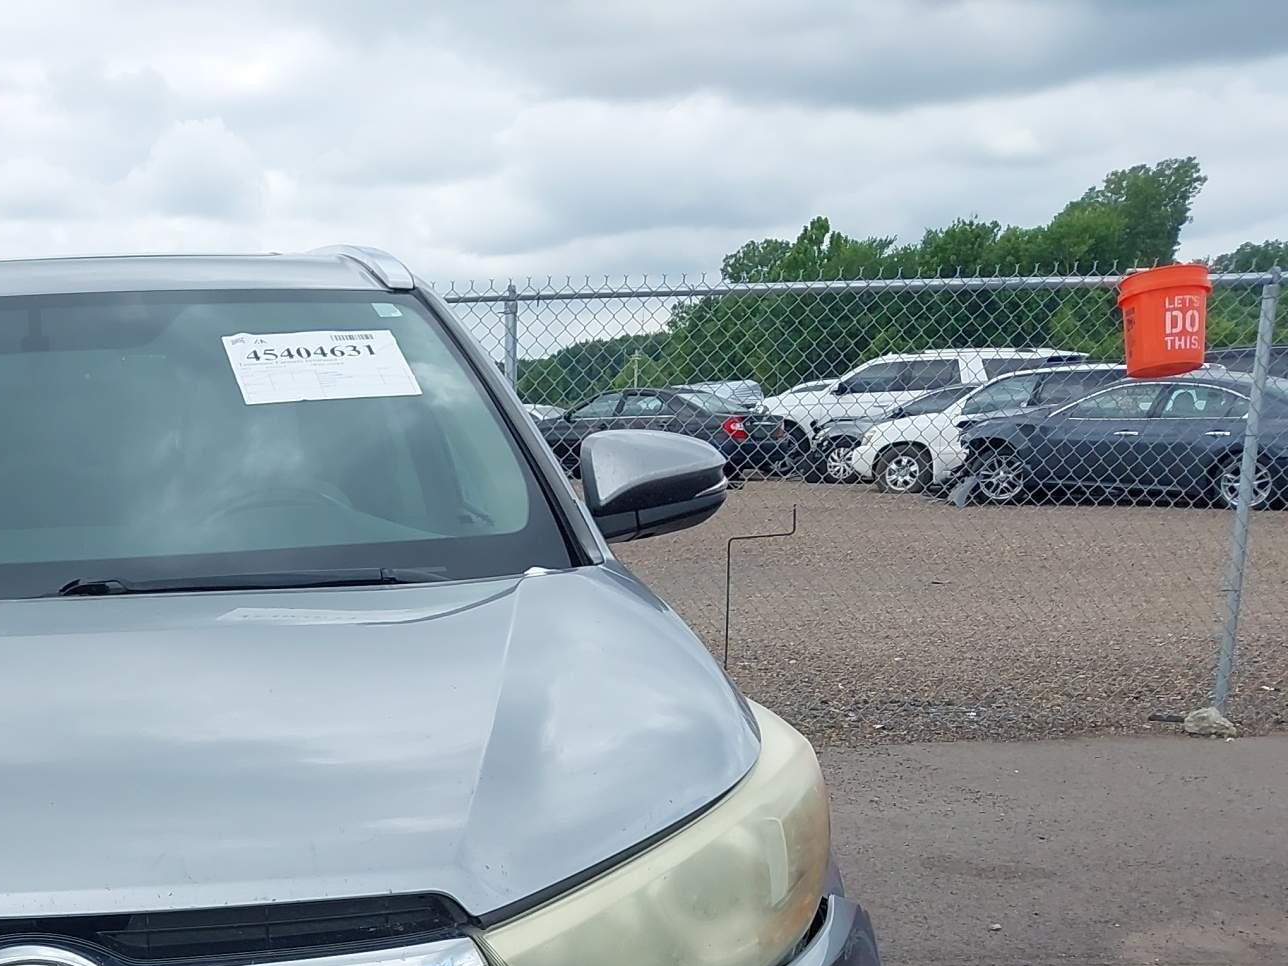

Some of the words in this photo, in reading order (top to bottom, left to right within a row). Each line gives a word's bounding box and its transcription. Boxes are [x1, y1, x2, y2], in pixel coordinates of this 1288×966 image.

[1165, 295, 1200, 309] LET'S
[1165, 310, 1200, 334] DO
[1164, 335, 1201, 350] THIS.
[245, 344, 377, 362] 45404631
